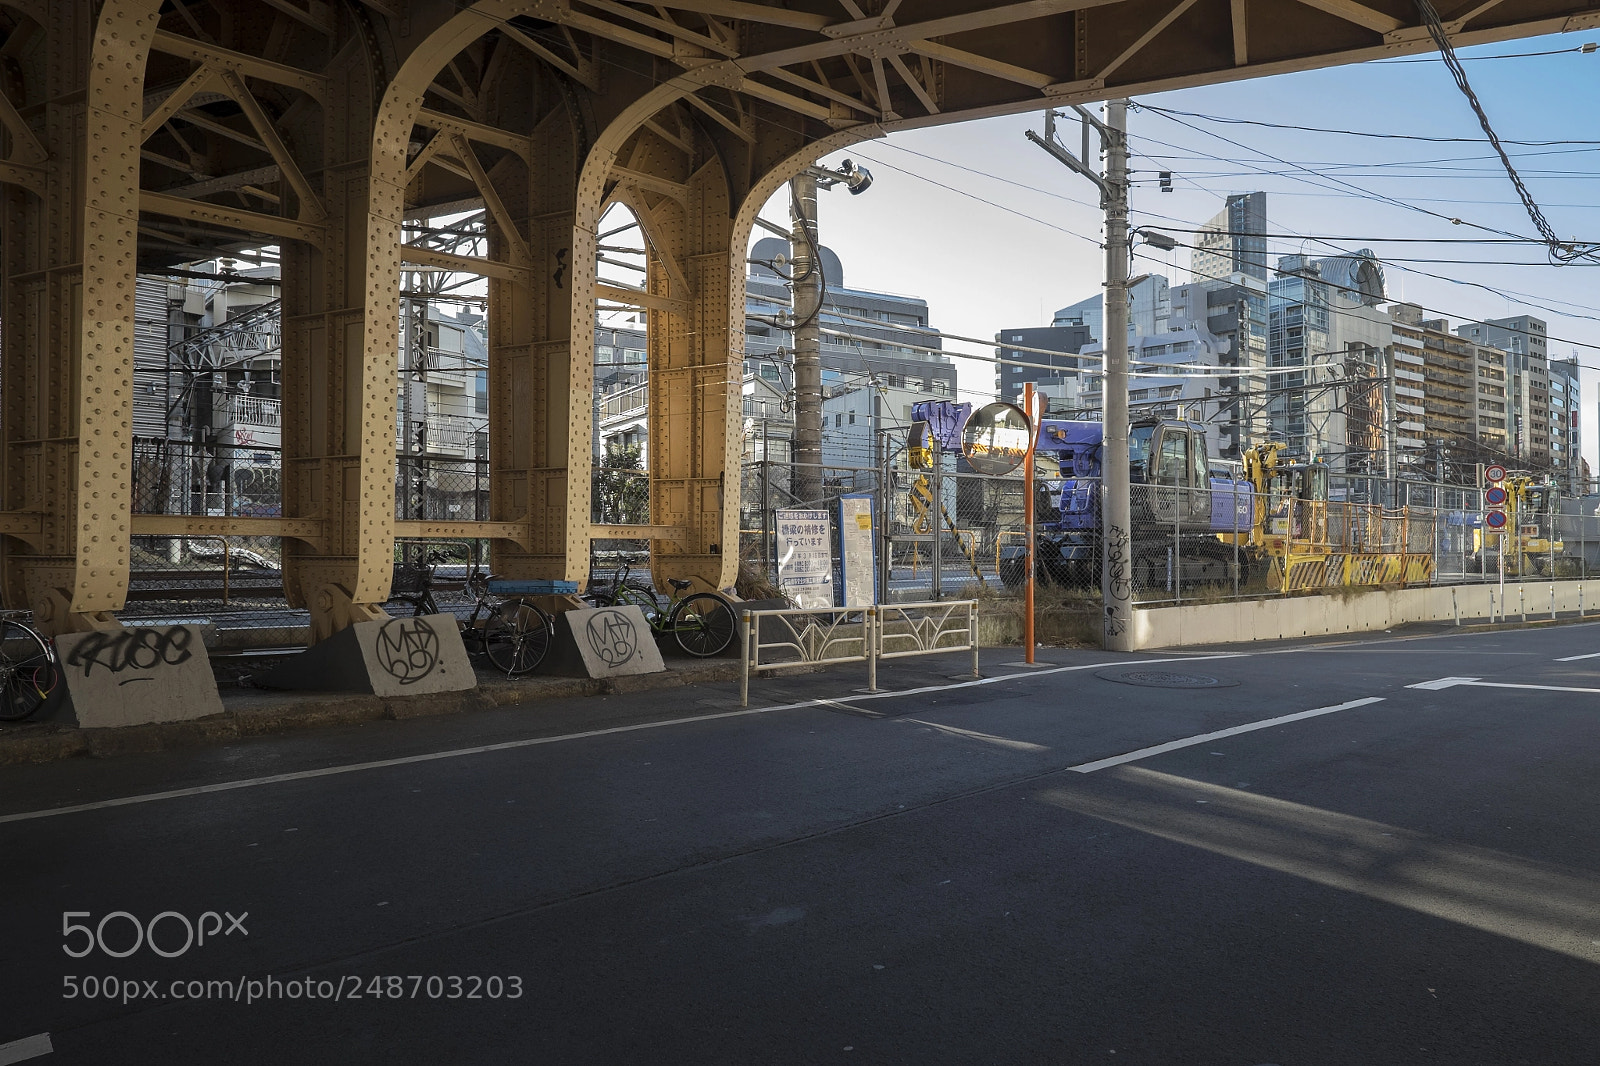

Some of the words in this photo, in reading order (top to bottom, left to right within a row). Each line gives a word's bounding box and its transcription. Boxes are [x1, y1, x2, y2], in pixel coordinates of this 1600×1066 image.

[1489, 470, 1502, 479] 30
[786, 537, 823, 547] 行っています
